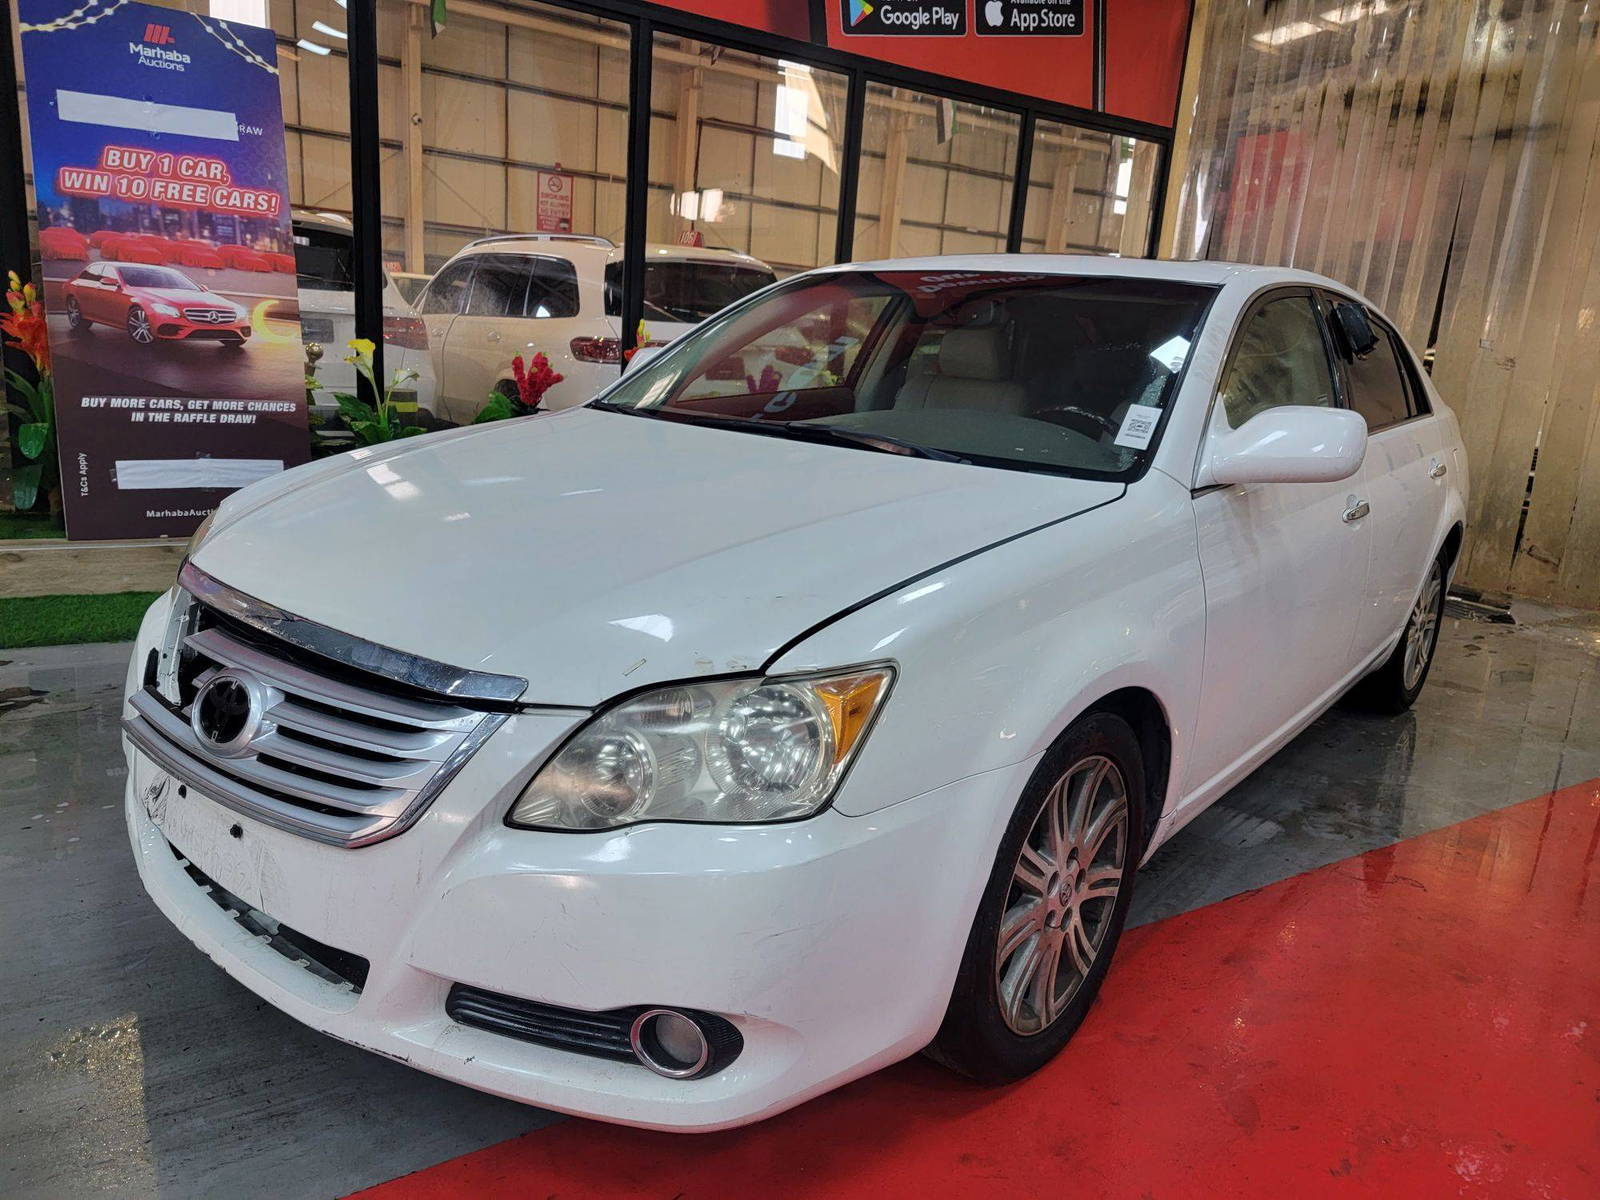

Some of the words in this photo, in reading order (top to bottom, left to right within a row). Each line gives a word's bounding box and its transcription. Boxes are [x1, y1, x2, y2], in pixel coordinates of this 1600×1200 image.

[880, 5, 930, 30] Google
[932, 7, 960, 30] Play
[1010, 8, 1039, 31] App
[1040, 8, 1076, 27] Store
[129, 42, 191, 64] Marhaba
[138, 55, 185, 72] Auctions
[238, 124, 264, 136] RAW
[106, 149, 152, 171] BUY
[159, 154, 171, 173] 1
[179, 159, 230, 182] CAR,
[64, 171, 109, 191] WIN
[117, 177, 146, 195] 10
[153, 181, 207, 204] FREE
[214, 188, 277, 213] CARS!
[81, 397, 107, 408] BUY
[110, 398, 146, 409] MORE
[149, 399, 184, 411] CARS,
[187, 400, 209, 410] GET
[212, 401, 244, 411] MORE
[247, 402, 296, 412] CHANCES
[131, 411, 145, 422] IN
[148, 413, 171, 422] THE
[173, 413, 217, 424] RAFFLE
[219, 414, 256, 424] DRAW!
[77, 452, 89, 475] Apply
[80, 476, 89, 497] T&Cs
[146, 508, 211, 518] MarhabaAuct
